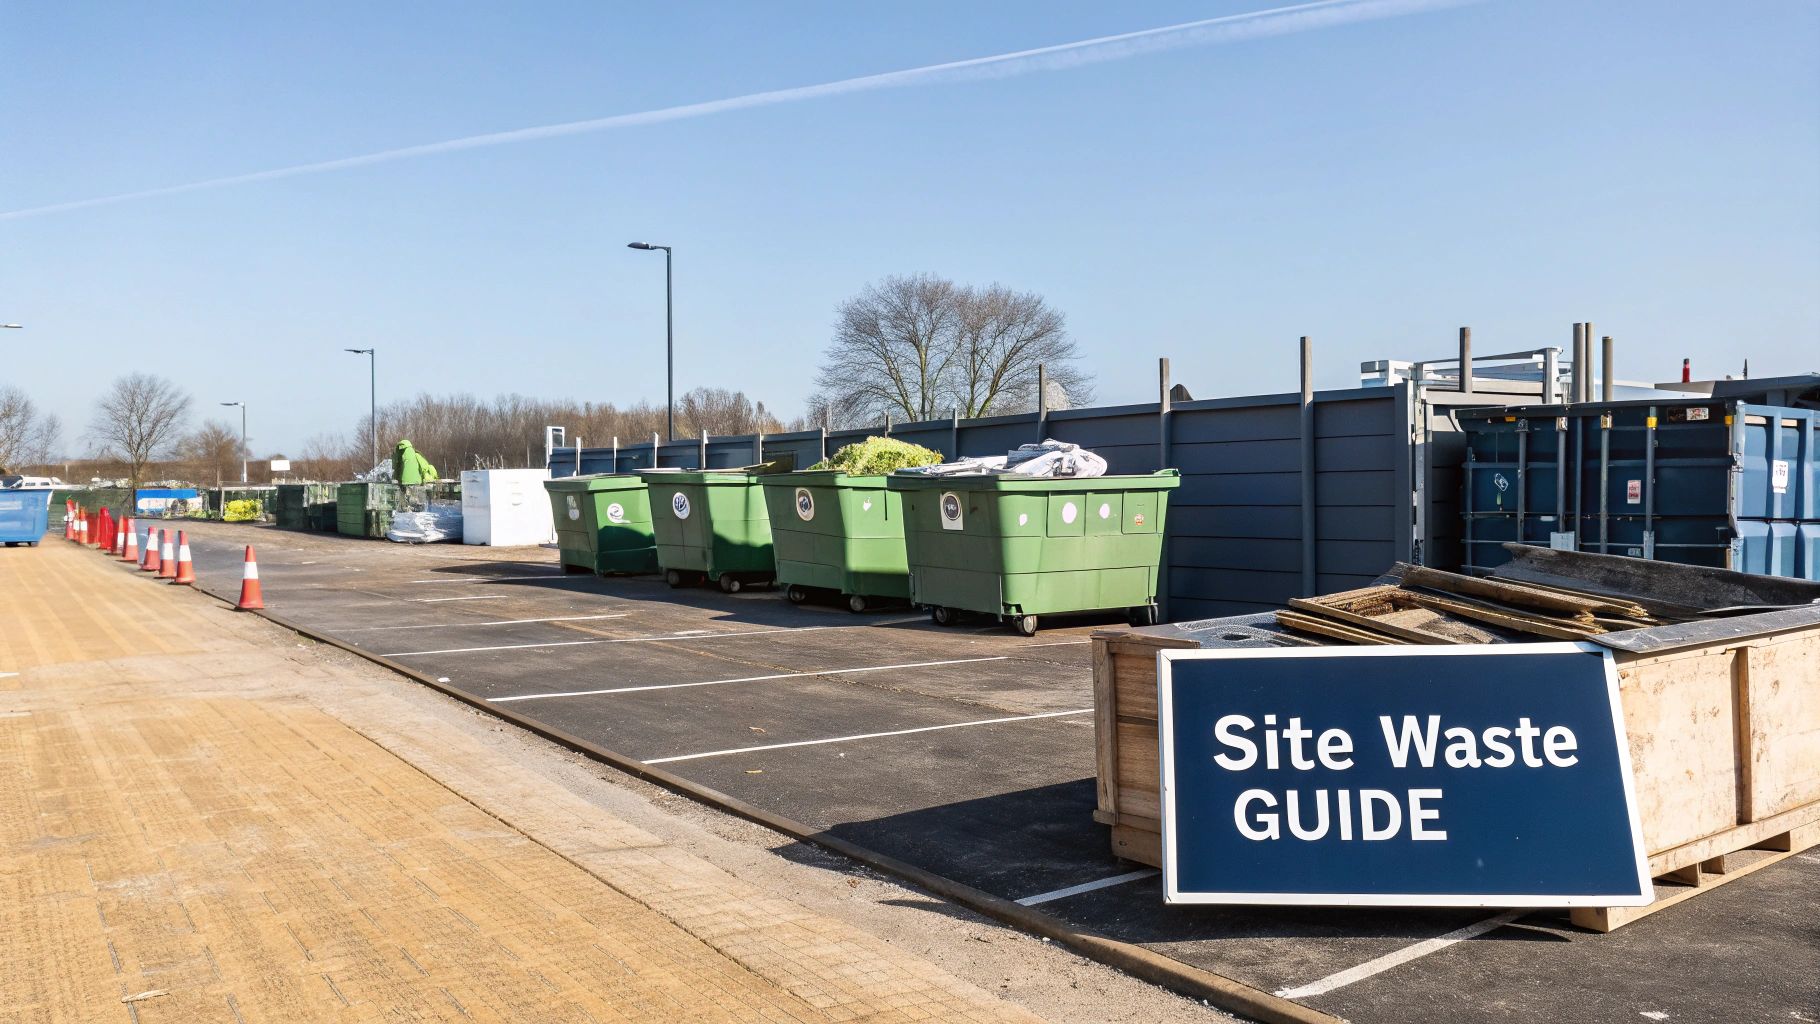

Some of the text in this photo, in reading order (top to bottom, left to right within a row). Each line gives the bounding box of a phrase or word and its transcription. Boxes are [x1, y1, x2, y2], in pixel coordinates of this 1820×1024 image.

[1213, 714, 1579, 771] Site Waste
[1233, 788, 1448, 841] GUIDE
